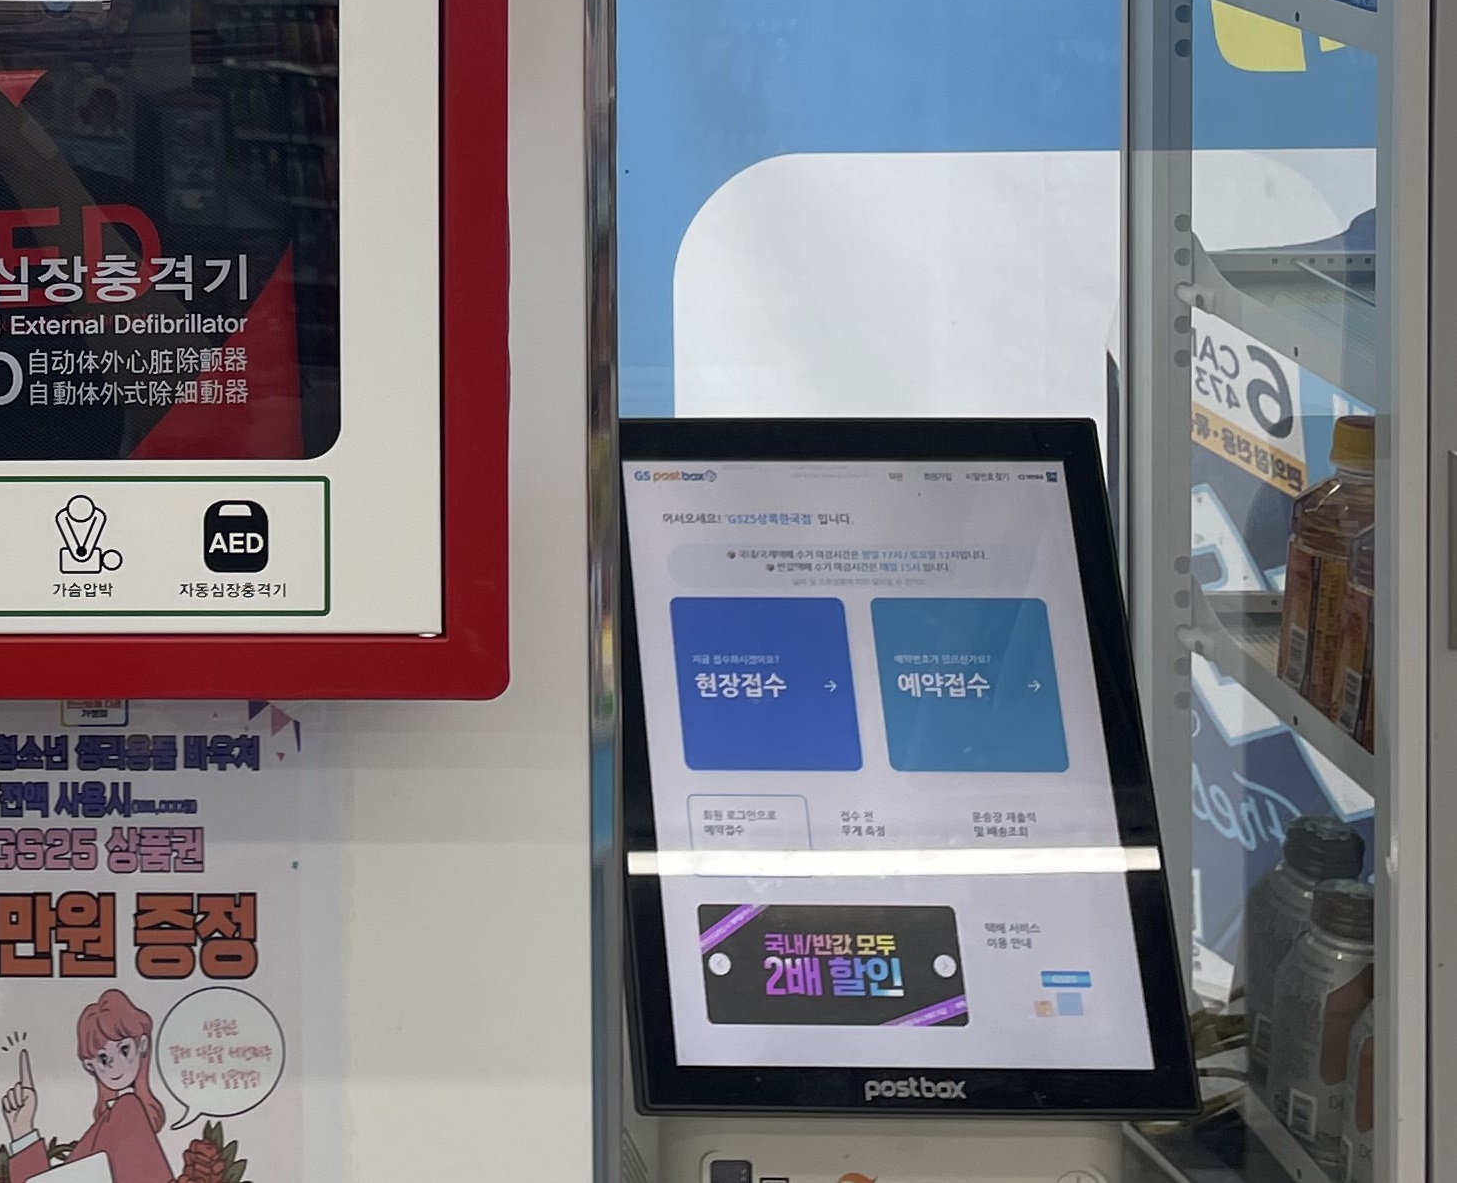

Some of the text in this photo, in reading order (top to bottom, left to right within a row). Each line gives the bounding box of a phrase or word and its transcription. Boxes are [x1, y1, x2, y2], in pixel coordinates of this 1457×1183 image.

[10, 314, 105, 335] External
[114, 313, 249, 335] Defibrillator
[28, 346, 248, 376] 自动体外心脏除颤器
[28, 379, 249, 406] 自動体外式除細動器
[633, 470, 651, 481] GS
[208, 532, 264, 554] AED
[52, 582, 114, 598] 가슴압박
[179, 582, 288, 598] 자동심장충격기
[694, 672, 788, 699] 현장접수
[896, 672, 992, 699] 예약접수
[183, 734, 261, 771] 바우처
[104, 826, 205, 874] 상품권
[132, 891, 259, 980] 증정
[763, 933, 897, 956] 국내/반값 모두
[763, 956, 906, 998] 2배 할인
[864, 1076, 967, 1101] postbox
